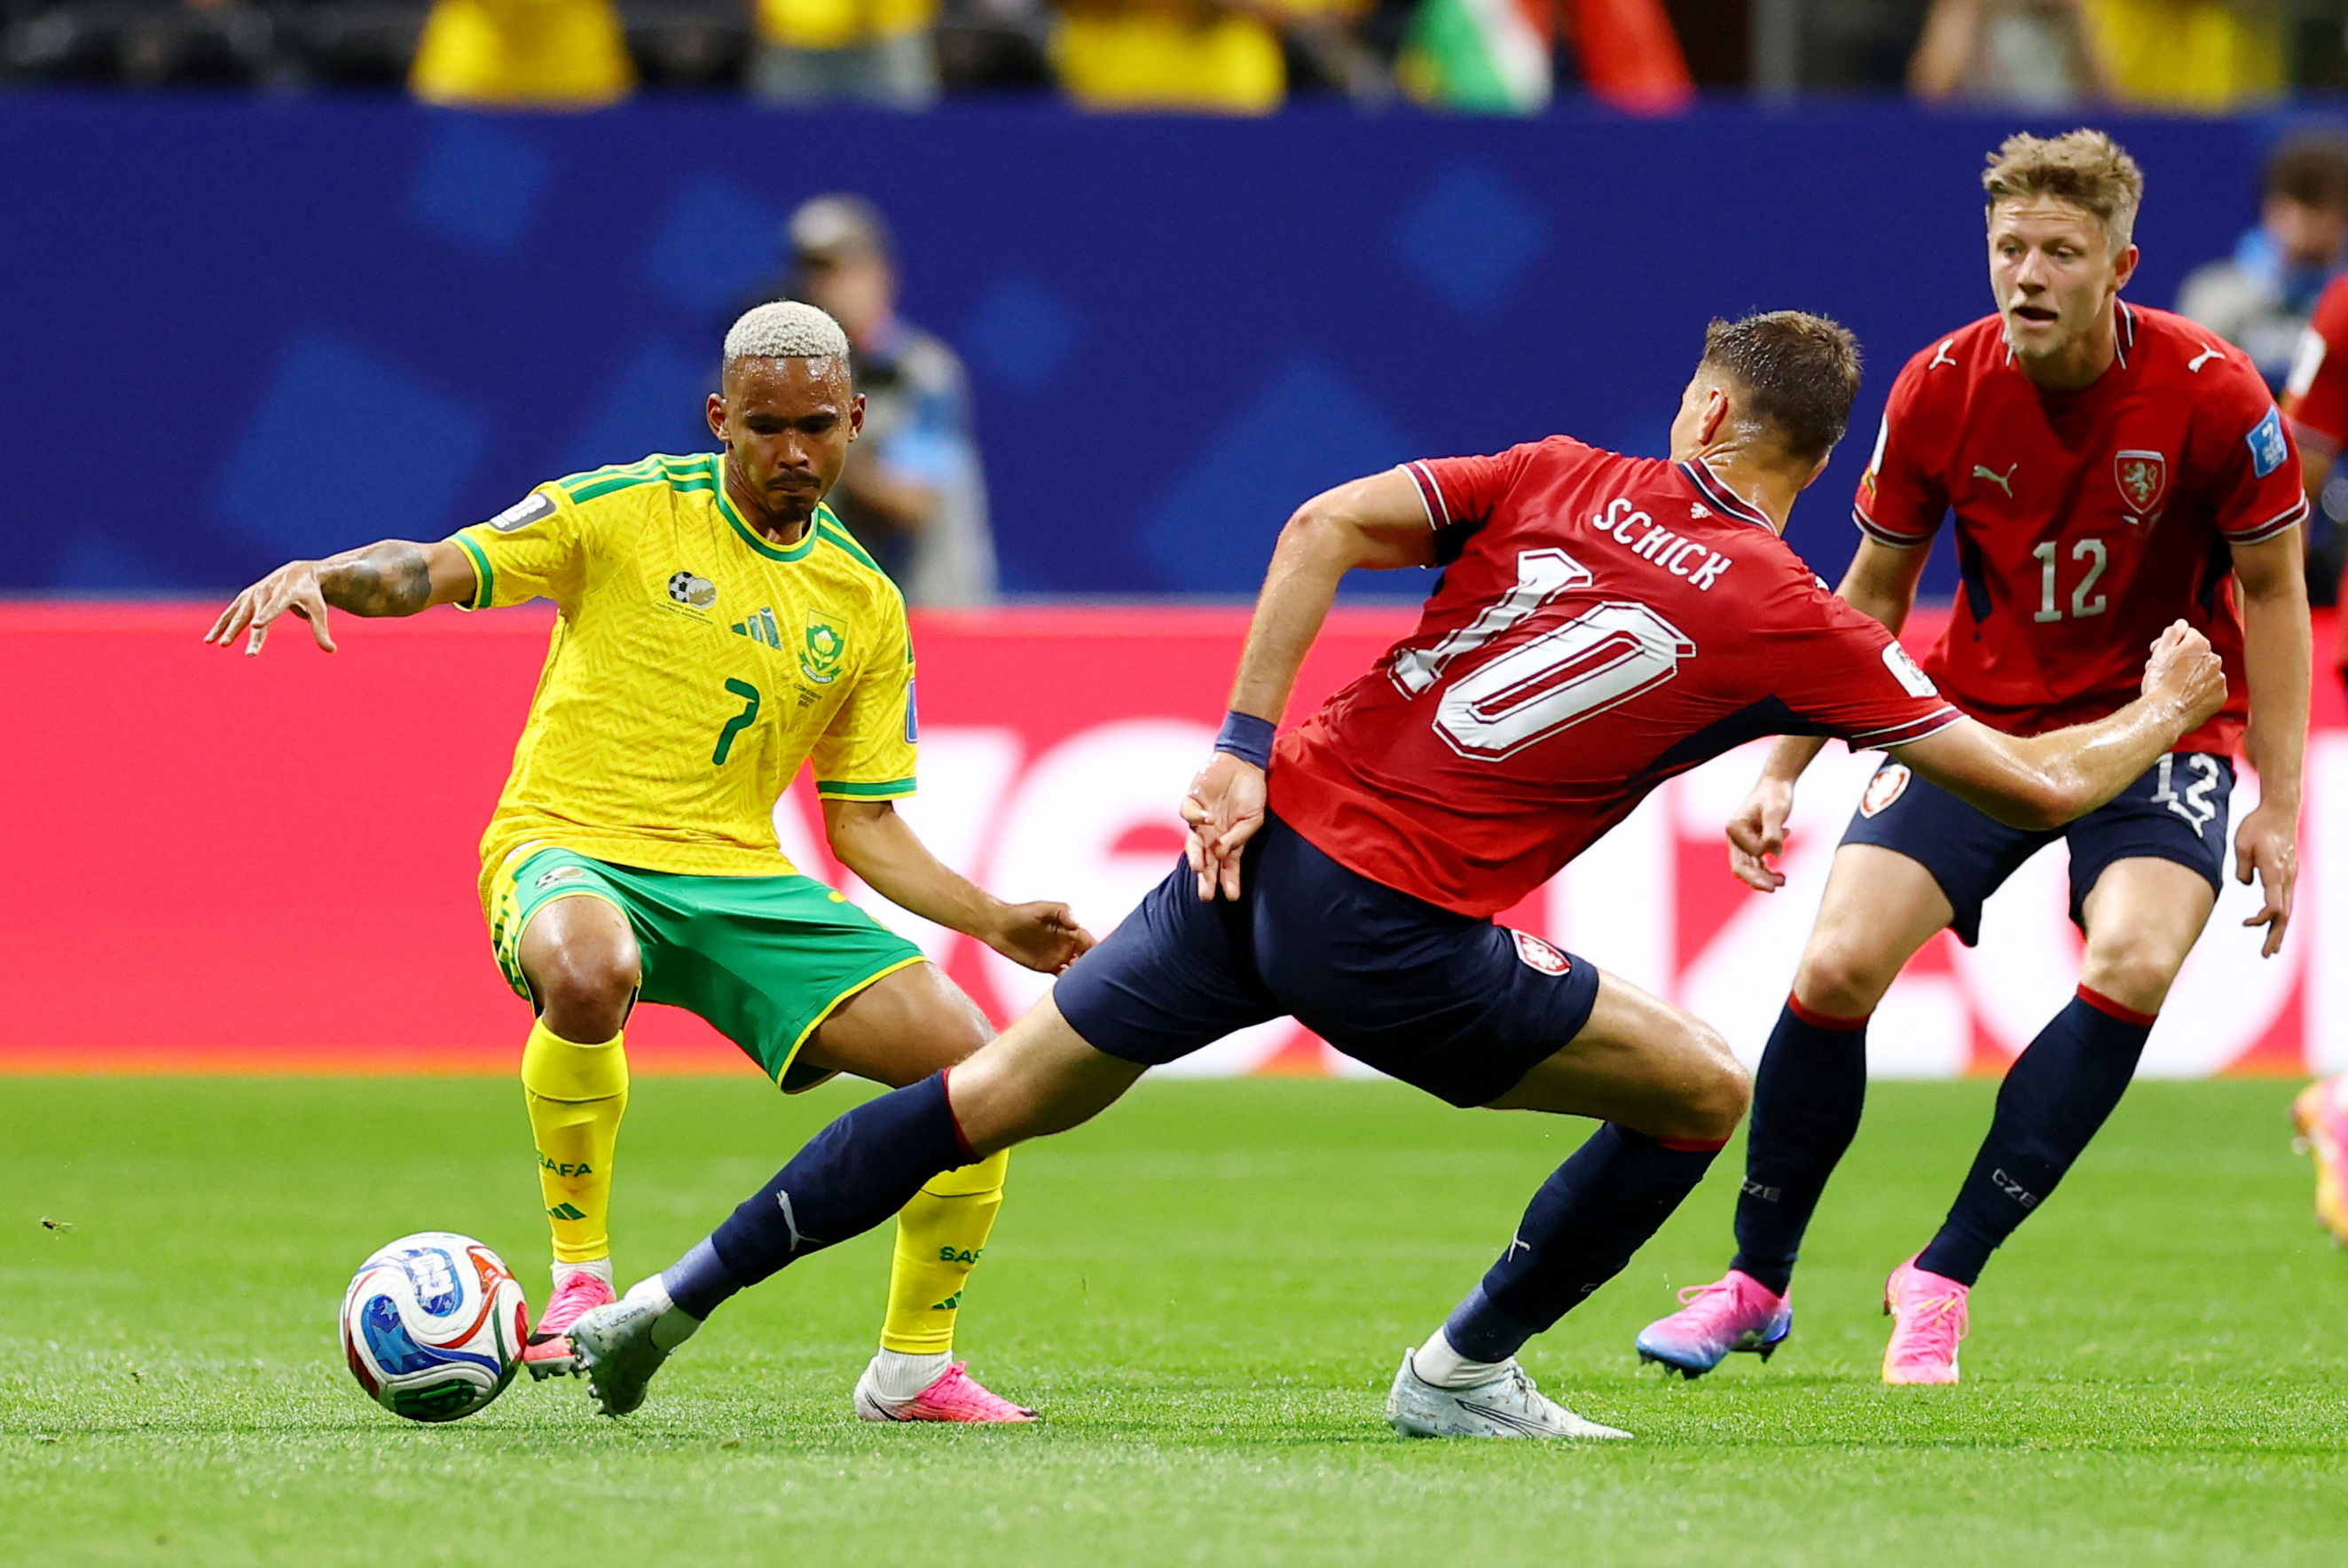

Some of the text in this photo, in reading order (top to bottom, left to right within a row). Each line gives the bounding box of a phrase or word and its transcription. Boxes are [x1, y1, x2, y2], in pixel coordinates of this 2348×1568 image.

[1593, 498, 1732, 591] SCHICK
[2032, 538, 2108, 623] 12
[1386, 547, 1697, 762] 10
[712, 677, 760, 766] 7
[2150, 752, 2219, 838] 12
[1991, 1167, 2038, 1210] CZE
[939, 1246, 984, 1264] SA
